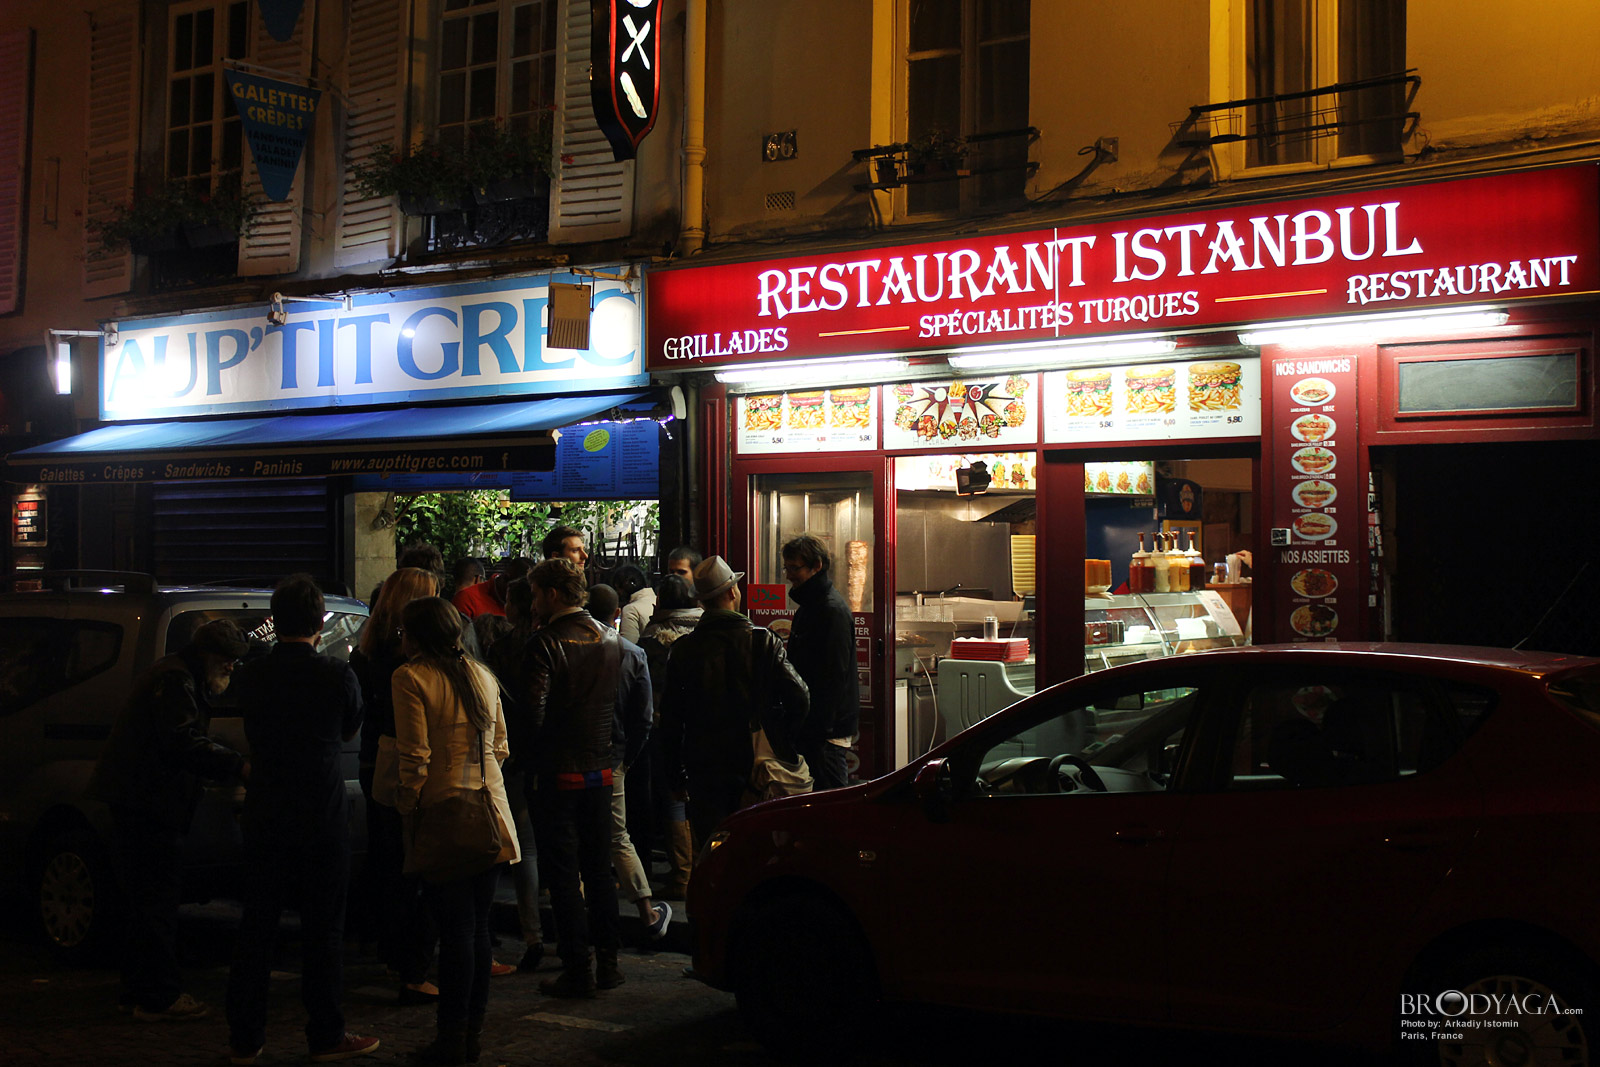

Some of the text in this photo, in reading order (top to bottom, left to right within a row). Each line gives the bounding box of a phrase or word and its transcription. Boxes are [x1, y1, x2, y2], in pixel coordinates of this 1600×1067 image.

[232, 82, 315, 113] GALETTES
[247, 105, 303, 130] CRÊPES
[757, 202, 1424, 319] RESTAURANT ISTANBUL
[1346, 255, 1578, 305] RESTAURANT
[918, 291, 1200, 338] SPÉCIALITÉS TURQUES
[663, 327, 789, 360] GRILLADES
[1276, 359, 1351, 376] NOS SANDWICHS
[39, 459, 303, 482] Galettes Crêpes Sandwichs Paninis
[330, 454, 484, 472] www.auptitgrec.com
[1281, 550, 1350, 564] NOS ASSIETTES
[752, 588, 782, 602] حلال
